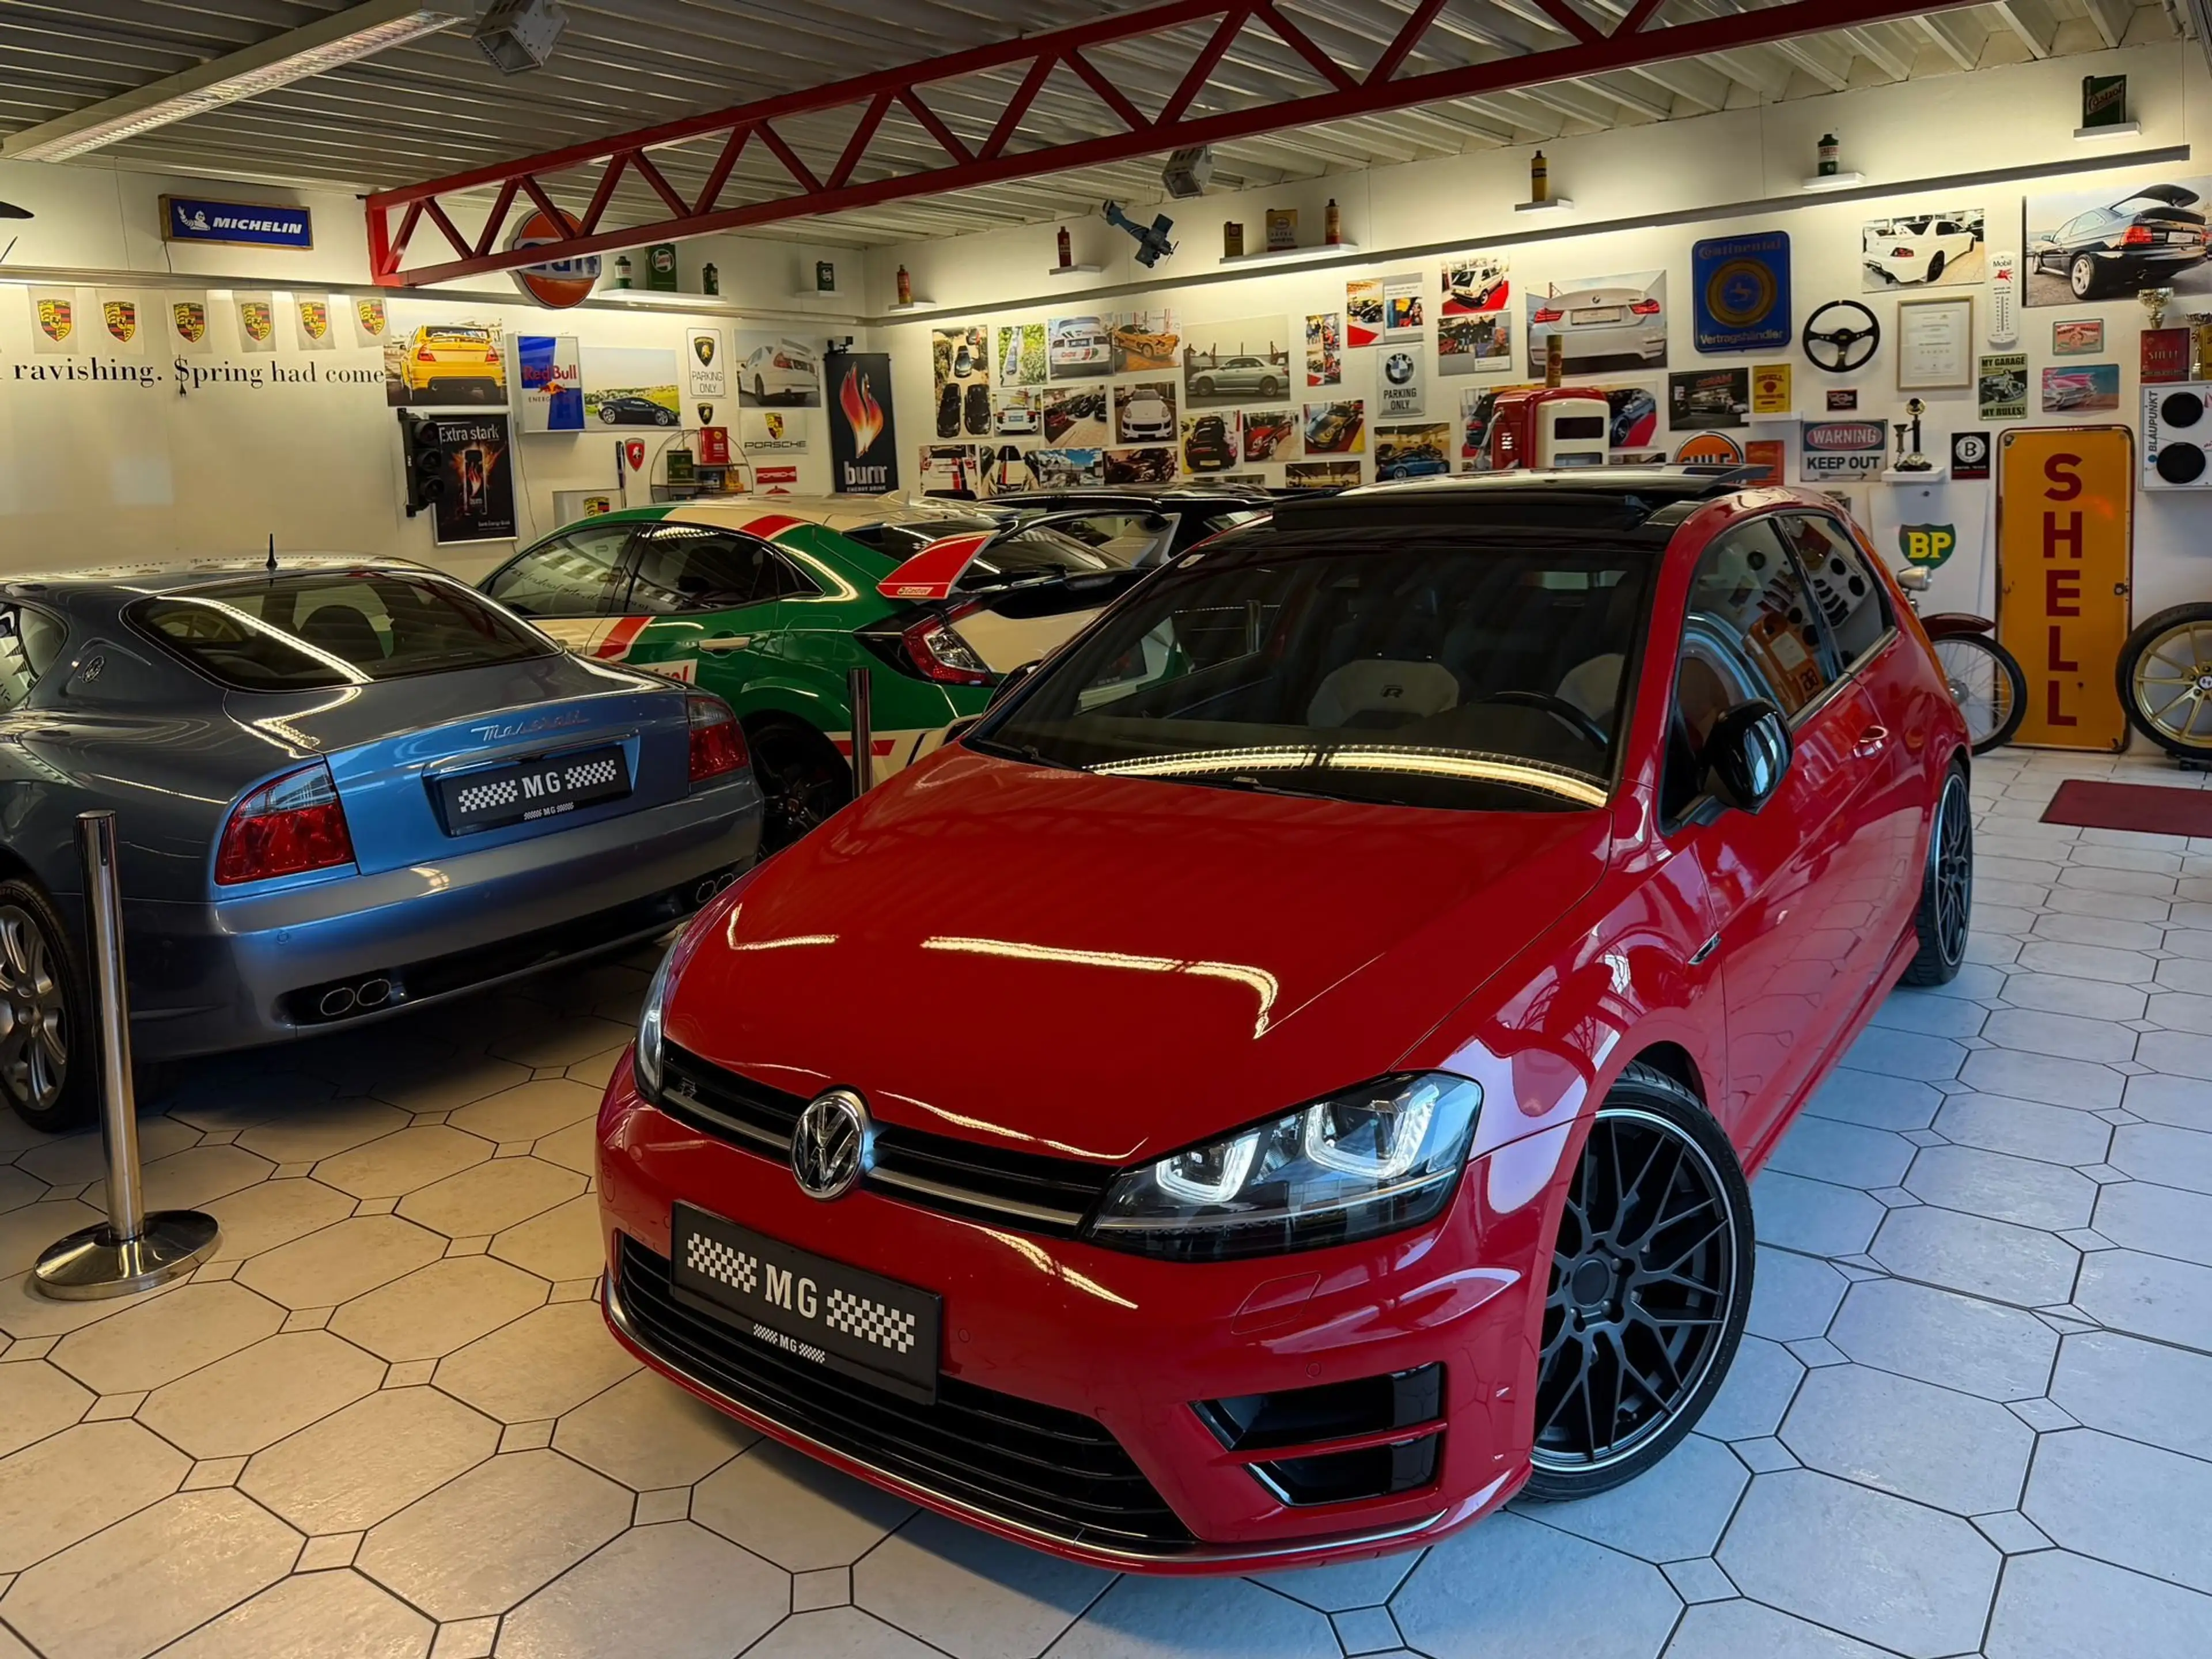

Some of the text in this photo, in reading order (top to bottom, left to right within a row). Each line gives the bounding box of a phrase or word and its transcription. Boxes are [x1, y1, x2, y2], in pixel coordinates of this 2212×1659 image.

[2089, 83, 2122, 112] Castrol
[213, 217, 302, 234] MICHELIN
[1698, 237, 1781, 259] Continental
[1700, 329, 1783, 344] Vertragshändler
[1982, 357, 2025, 367] MY GARAGE
[13, 357, 162, 388] ravishing.
[270, 361, 317, 382] had
[326, 369, 385, 383] come
[522, 365, 577, 381] Red Bull
[692, 371, 723, 381] PARKING
[699, 383, 717, 393] ONLY
[1384, 388, 1417, 400] PARKING
[1391, 399, 1410, 410] ONLY
[1982, 407, 2025, 416] MY RULES!
[2149, 391, 2158, 452] BLAUPUNKT
[439, 423, 500, 443] Extra stark
[1813, 429, 1877, 444] WARNING
[744, 440, 807, 449] PORSCHE
[1807, 456, 1880, 470] KEEP OUT
[844, 460, 888, 485] burn
[1908, 532, 1952, 559] BP
[2043, 453, 2083, 726] SHELL
[521, 772, 561, 799] MG
[543, 806, 556, 816] MG
[764, 1263, 817, 1319] MG
[779, 1333, 798, 1353] MG
